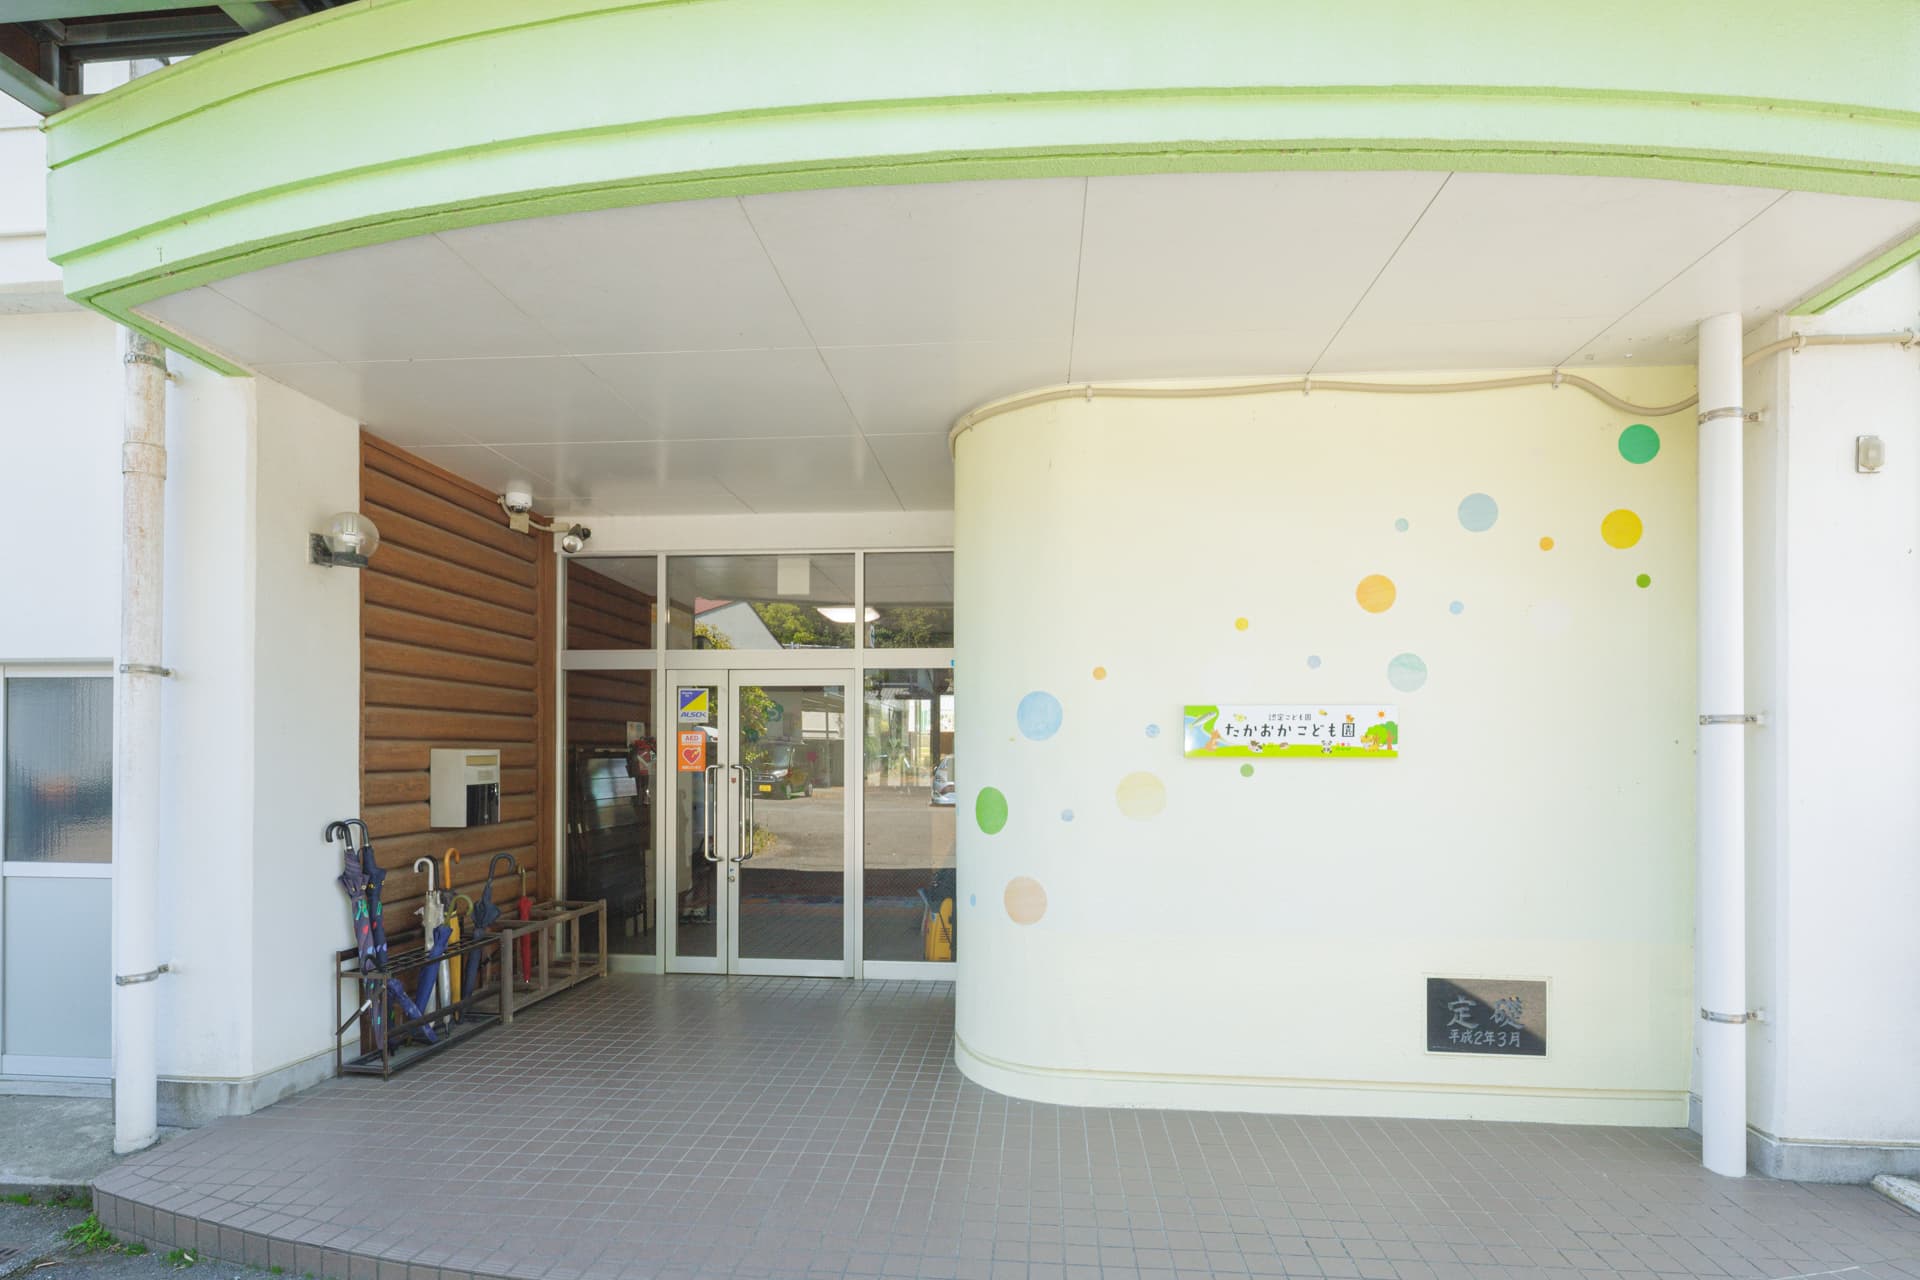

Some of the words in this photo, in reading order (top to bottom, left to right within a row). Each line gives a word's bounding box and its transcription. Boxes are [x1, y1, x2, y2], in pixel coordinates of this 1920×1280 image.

[1225, 723, 1355, 738] たかおかこども園
[1448, 1029, 1520, 1048] 平成2年3月
